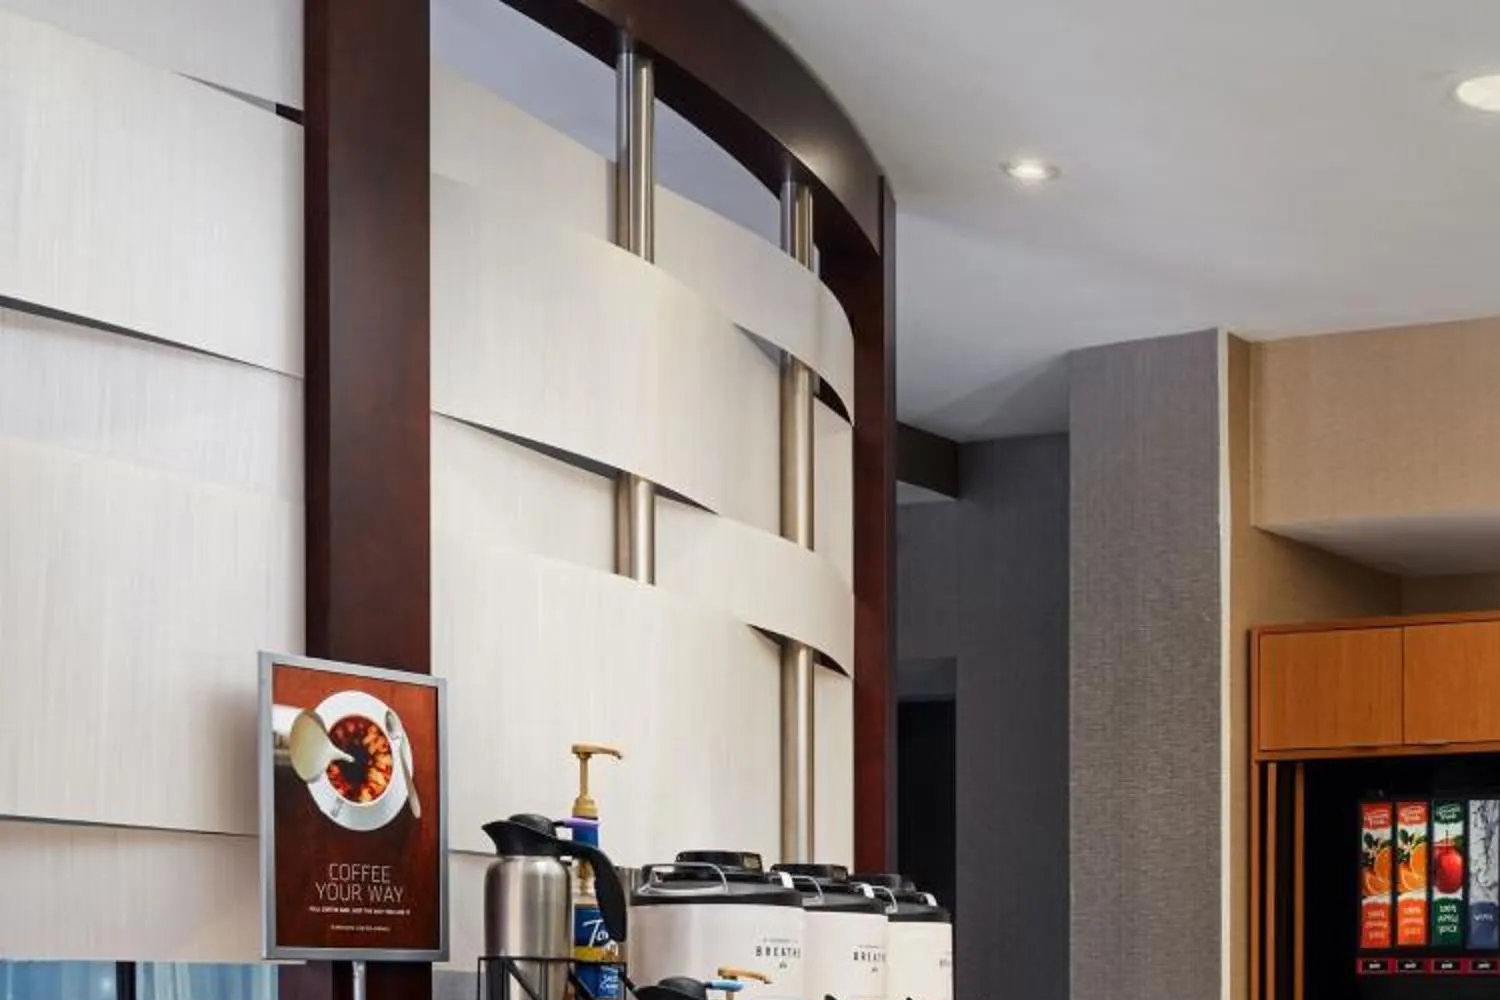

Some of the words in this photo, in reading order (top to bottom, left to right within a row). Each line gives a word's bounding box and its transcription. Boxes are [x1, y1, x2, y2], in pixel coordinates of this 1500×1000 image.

[328, 863, 392, 883] COFFEE
[315, 882, 363, 901] YOUR
[367, 885, 403, 903] WAY
